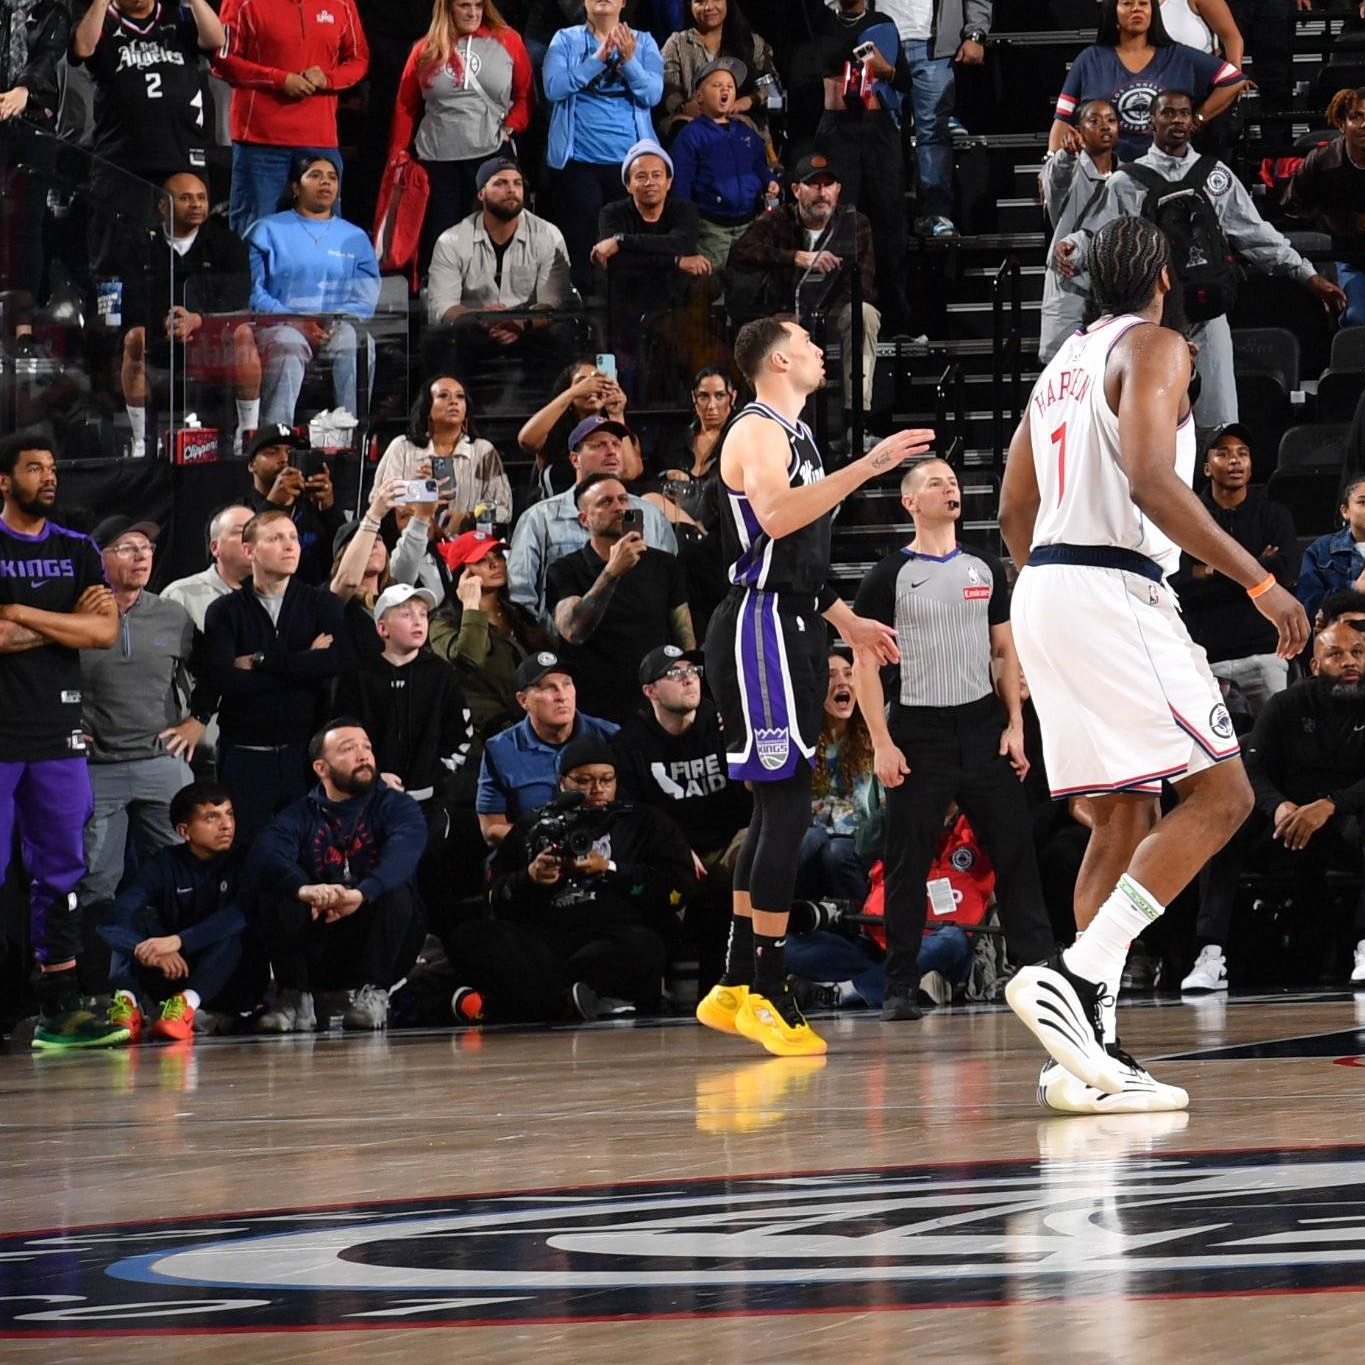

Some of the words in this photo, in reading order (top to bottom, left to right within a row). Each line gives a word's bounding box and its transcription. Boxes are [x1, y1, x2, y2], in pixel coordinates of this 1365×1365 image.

[115, 44, 186, 74] Angeles
[128, 38, 159, 55] Los
[144, 71, 164, 99] 2
[182, 438, 220, 462] Clippers
[1049, 420, 1068, 509] 1
[0, 557, 76, 579] KINGS
[669, 752, 721, 779] FIRE
[684, 772, 728, 800] AID
